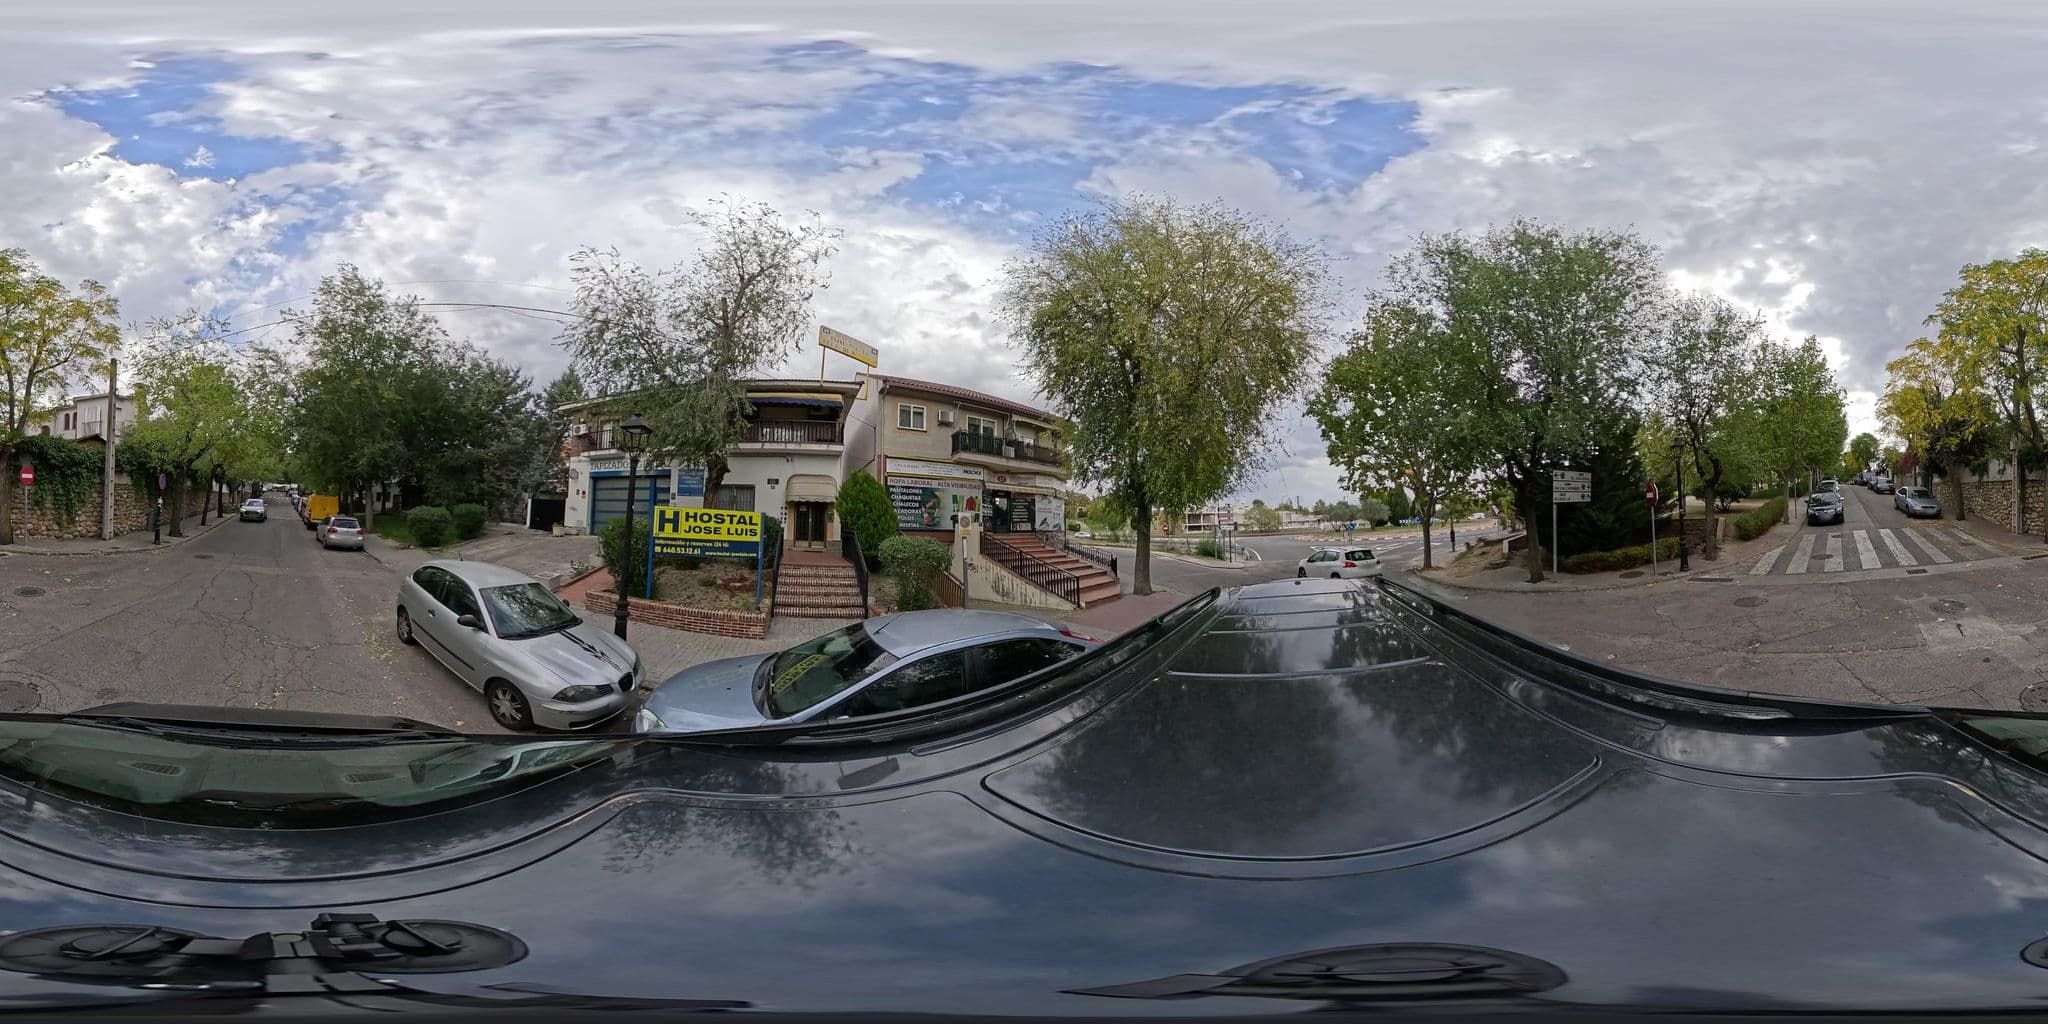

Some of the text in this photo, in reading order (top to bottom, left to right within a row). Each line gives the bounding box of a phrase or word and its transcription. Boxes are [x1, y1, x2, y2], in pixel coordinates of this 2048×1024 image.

[906, 479, 933, 487] LABORAL
[950, 482, 982, 490] VISIBILIDAD
[889, 487, 923, 495] PANTALONES
[658, 510, 681, 533] H
[685, 512, 759, 526] HOSTAL
[684, 525, 759, 537] JOSE LUIS
